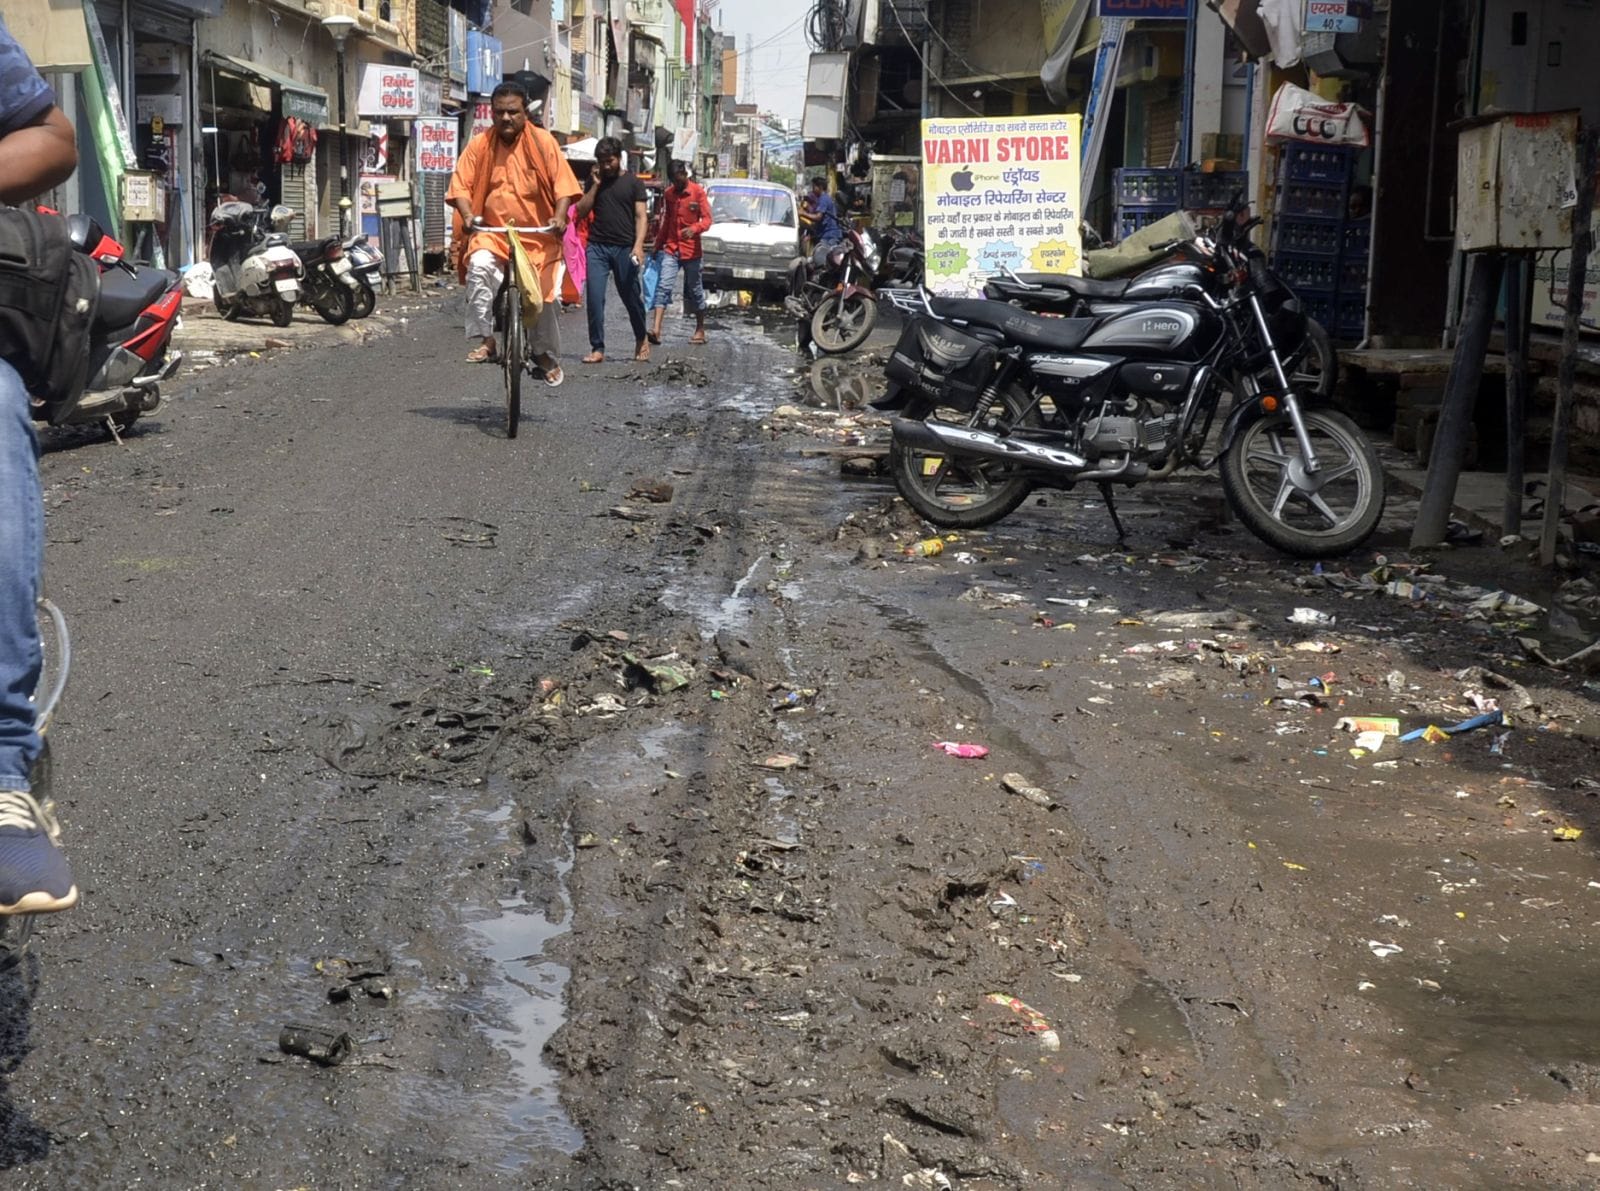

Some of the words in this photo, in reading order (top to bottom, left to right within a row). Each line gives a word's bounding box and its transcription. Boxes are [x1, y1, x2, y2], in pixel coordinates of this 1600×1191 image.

[1311, 3, 1345, 14] एयरफ
[1322, 19, 1334, 29] 40
[382, 75, 415, 88] रिमोट
[382, 94, 414, 108] रिमोट
[1007, 121, 1027, 131] सबसे
[1029, 123, 1048, 131] सस्ता
[1050, 120, 1067, 130] स्टोर
[421, 125, 456, 142] रिमोट
[924, 138, 990, 164] VARNI
[997, 135, 1069, 162] STORE
[420, 152, 455, 169] रिमोट
[974, 174, 1000, 182] iPhone
[937, 192, 981, 207] मोबाइल
[985, 189, 1032, 205] रिपेयरिंग
[1563, 191, 1576, 201] 96
[928, 212, 945, 225] हमारे
[962, 214, 971, 223] हर
[973, 214, 992, 223] प्रकार
[994, 210, 1001, 221] के
[1003, 210, 1031, 222] मोबाइल
[1032, 208, 1042, 220] की
[938, 226, 947, 238] की
[950, 226, 967, 238] जाती
[976, 226, 994, 238] सबसे
[996, 224, 1014, 236] सस्ती
[1026, 224, 1044, 236] सबसे
[1153, 322, 1180, 331] Hero
